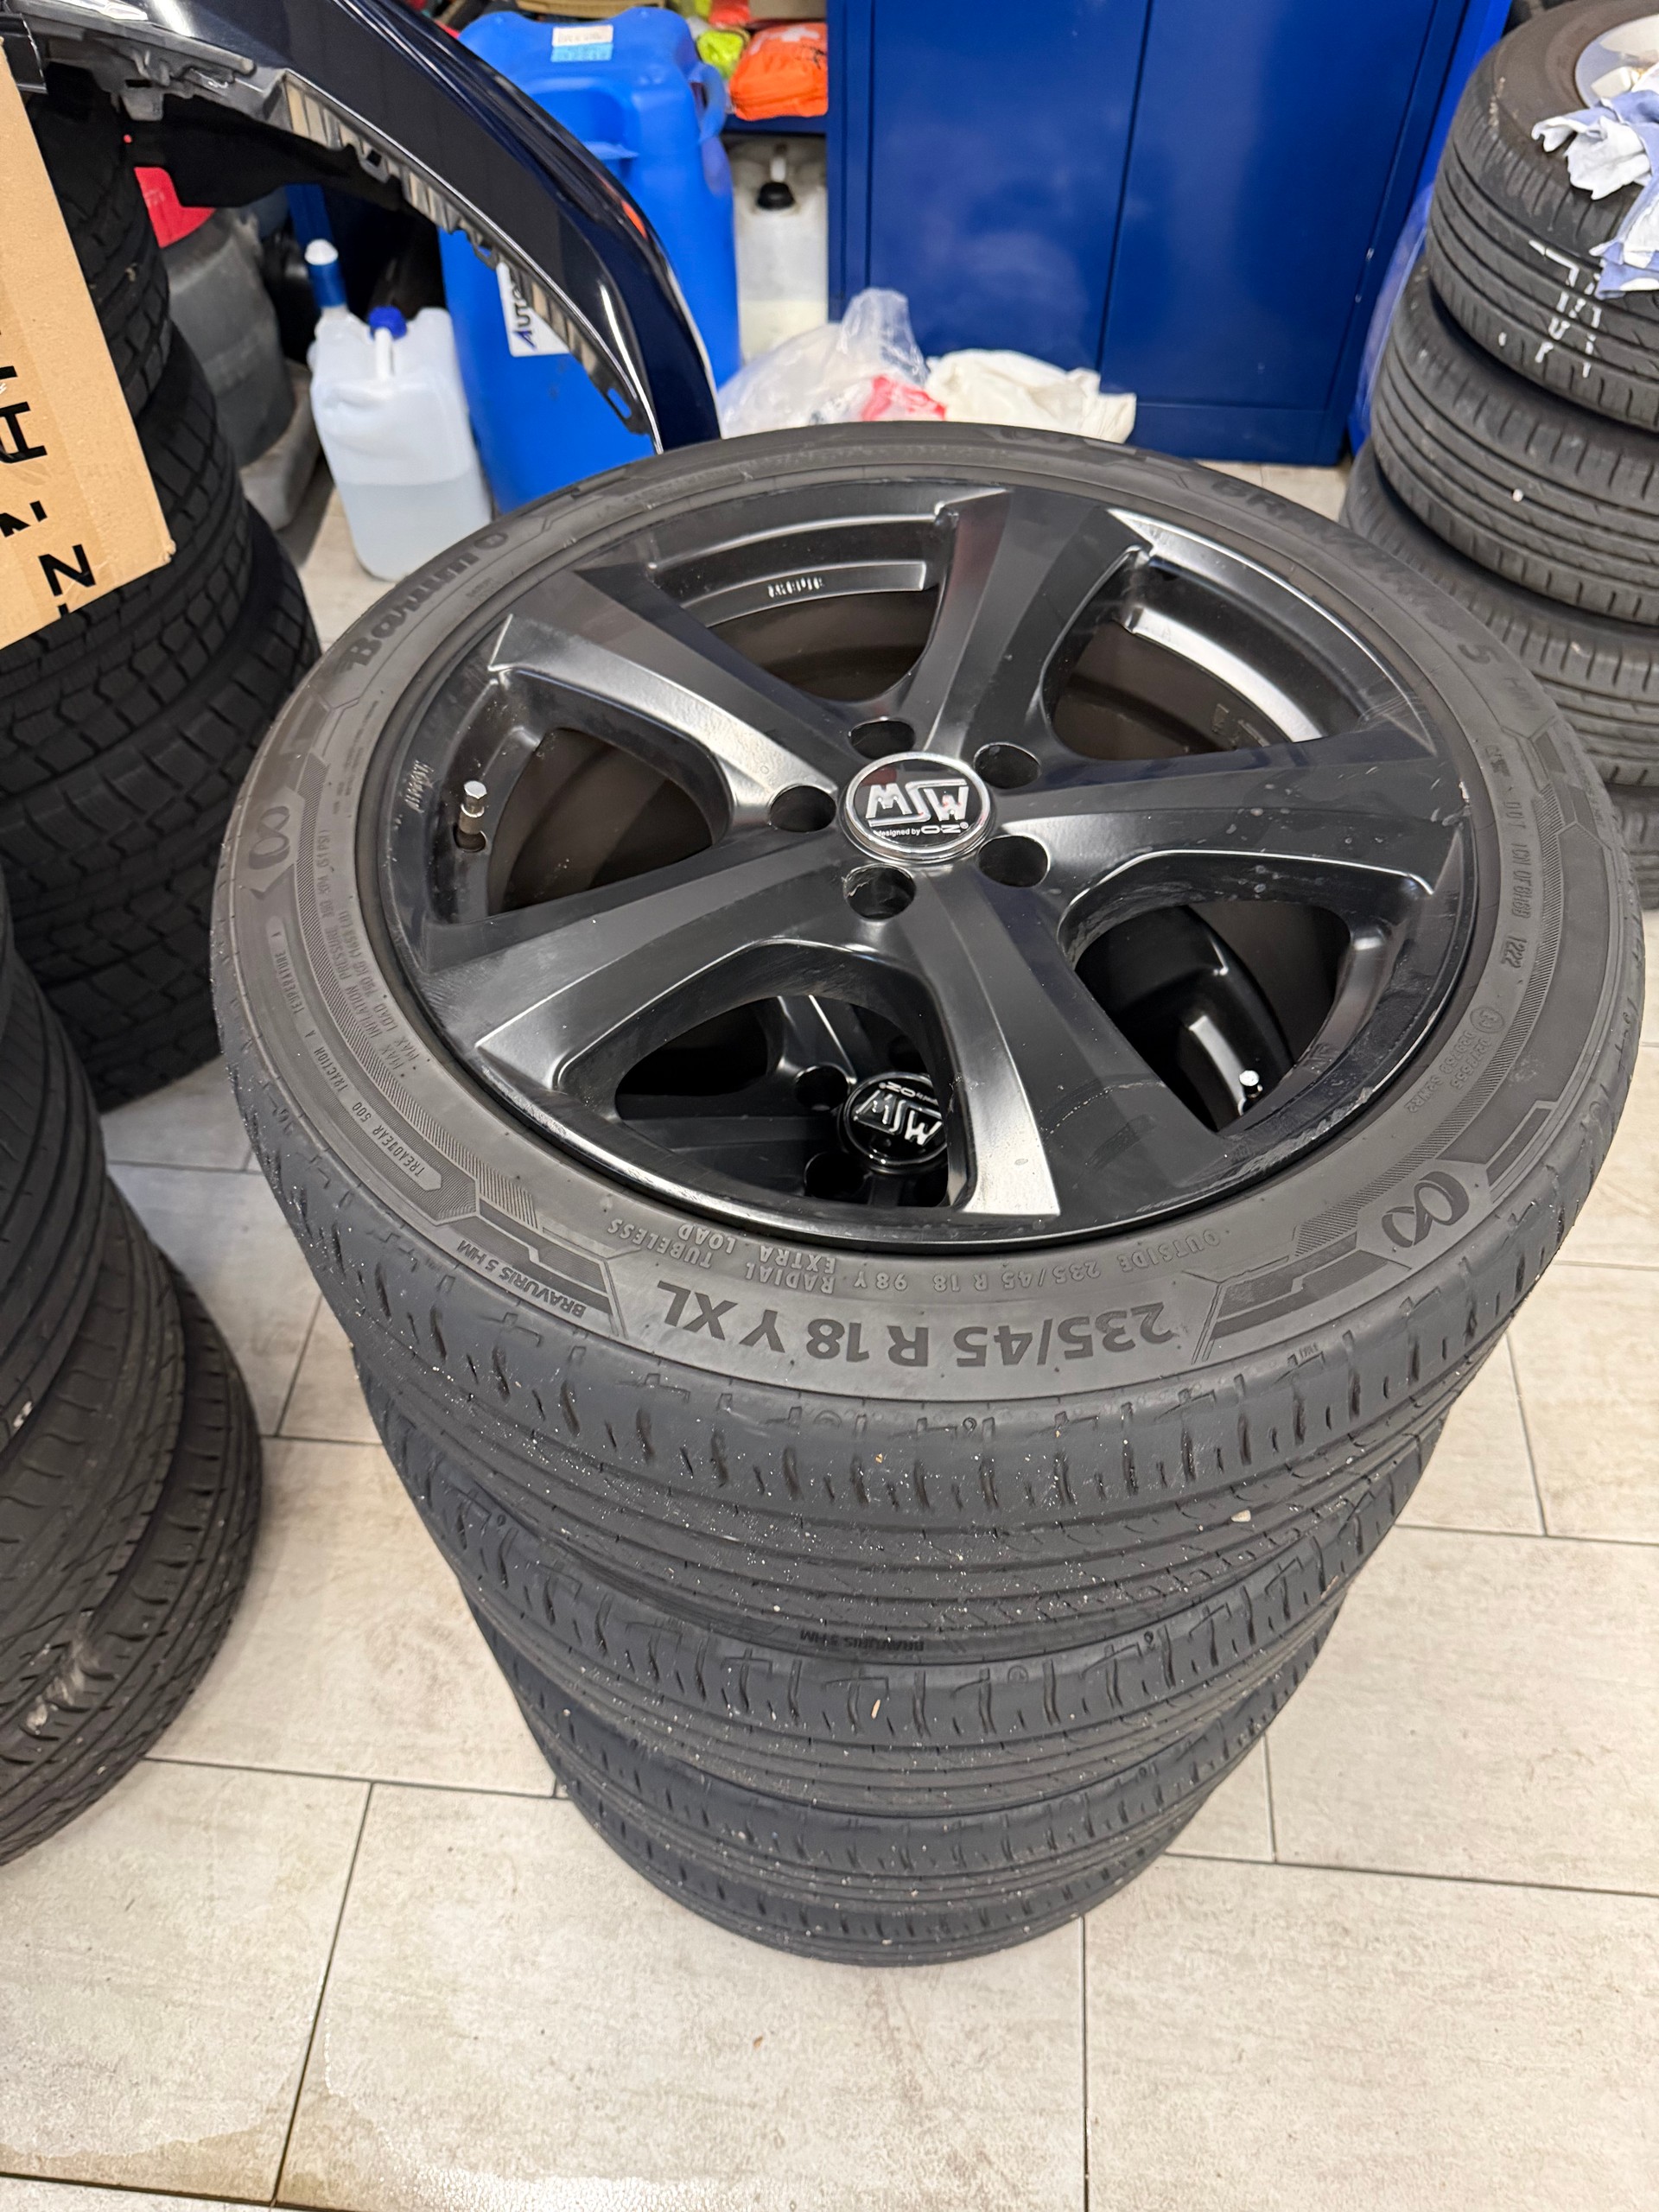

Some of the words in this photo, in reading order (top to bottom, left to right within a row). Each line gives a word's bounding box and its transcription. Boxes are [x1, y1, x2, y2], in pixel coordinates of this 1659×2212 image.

[350, 550, 483, 666] Barum
[866, 779, 969, 827] MSW
[911, 827, 921, 838] by
[1501, 934, 1529, 969] 1222
[344, 984, 384, 1039] INFLATION
[372, 1002, 398, 1033] LOAD
[378, 1044, 405, 1071] MAX
[393, 1037, 421, 1062] MAX
[314, 1046, 349, 1093] TRACTION
[352, 1101, 372, 1123] 500
[456, 1239, 486, 1266] HM
[607, 1218, 714, 1268] TUBELESS
[677, 1223, 737, 1255] LOAD
[1118, 1229, 1221, 1272] OUTSIDE
[484, 1258, 499, 1273] 5
[759, 1245, 836, 1274] EXTRA
[1001, 1261, 1102, 1290] 235/45
[499, 1266, 588, 1319] BRAVURIS
[745, 1262, 836, 1294] RADIAL
[854, 1270, 868, 1289] Y
[875, 1271, 908, 1292] 98
[932, 1274, 961, 1293] 18
[973, 1274, 988, 1292] R
[656, 1280, 739, 1340] XL
[739, 1308, 785, 1353] Y
[805, 1318, 870, 1363] 18
[887, 1325, 929, 1367] R
[952, 1301, 1174, 1367] 235/45
